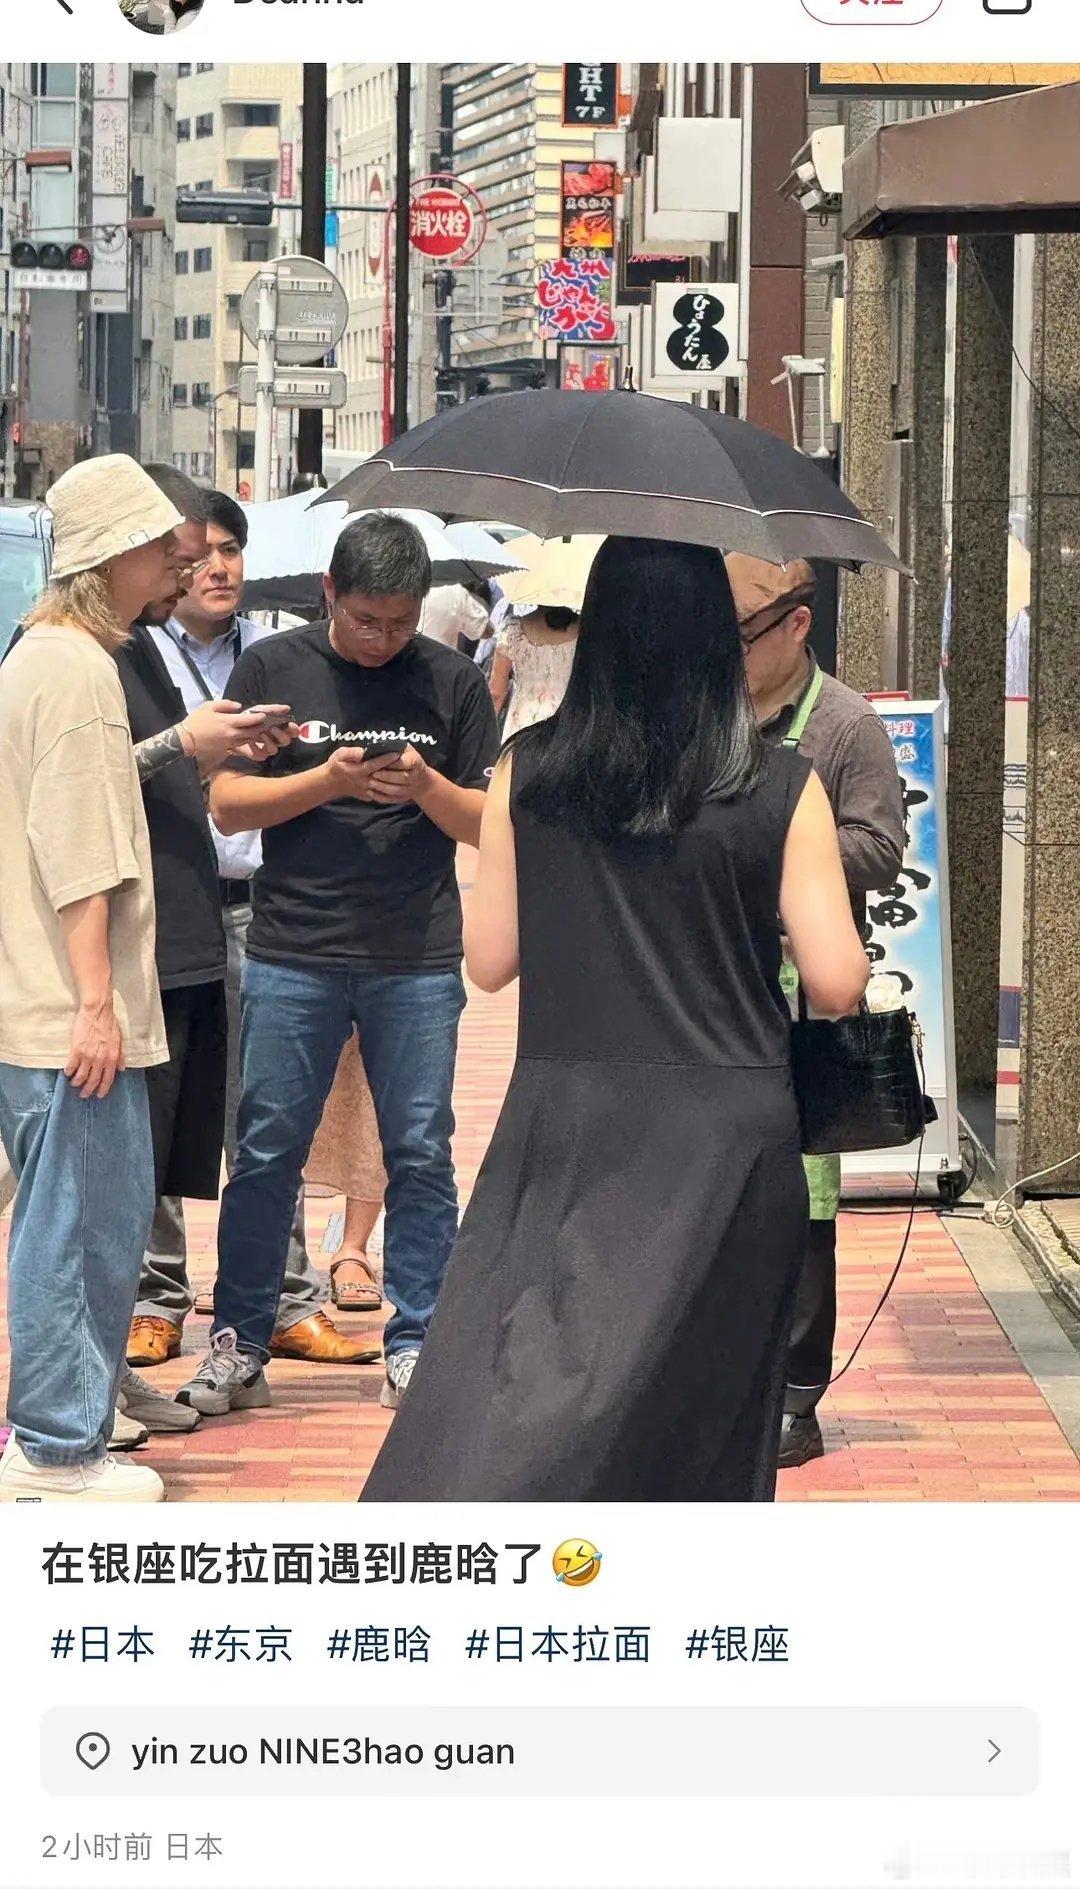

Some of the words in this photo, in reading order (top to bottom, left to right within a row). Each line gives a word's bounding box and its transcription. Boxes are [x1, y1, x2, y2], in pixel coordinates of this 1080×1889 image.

[578, 63, 603, 102] HT
[574, 105, 606, 119] 7F
[410, 210, 467, 238] 消火栓
[549, 258, 612, 280] 九州
[682, 294, 712, 371] ひょうたん屋
[299, 720, 437, 745] Champion
